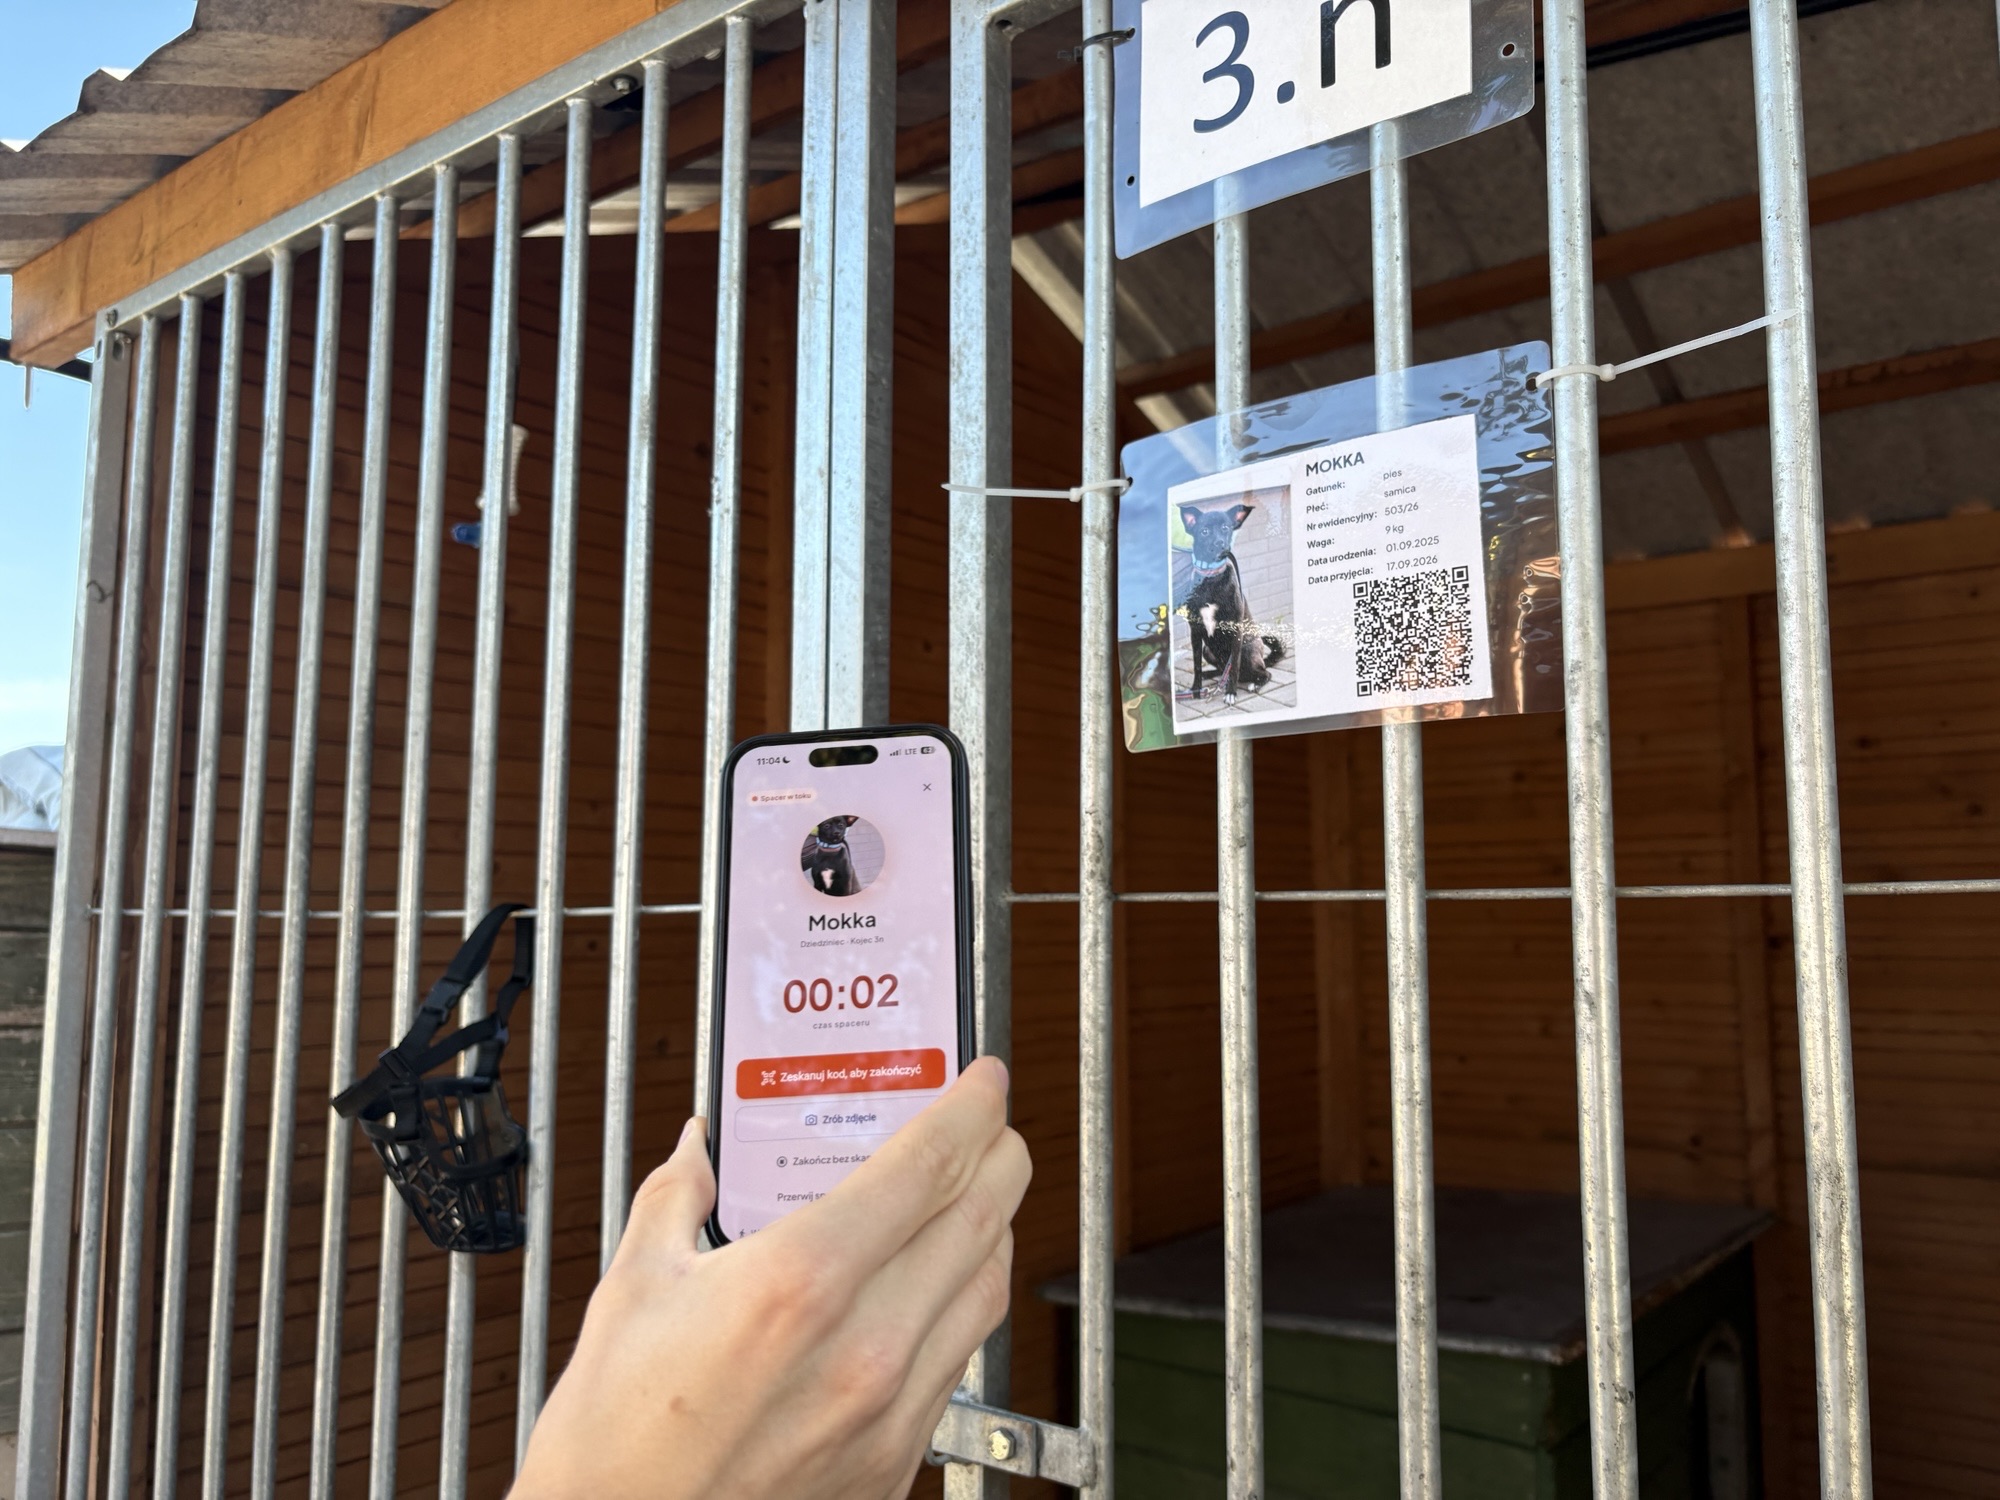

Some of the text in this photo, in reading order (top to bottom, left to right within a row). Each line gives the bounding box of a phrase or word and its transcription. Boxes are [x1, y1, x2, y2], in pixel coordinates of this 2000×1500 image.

[1306, 451, 1365, 477] MOKKA
[1305, 469, 1403, 496] Gatunek: pies
[1306, 485, 1416, 514] Płeć: samica
[1306, 502, 1419, 532] Nr ewidencyjny: 503/26
[1306, 524, 1404, 549] Waga: 9 kg
[1307, 535, 1440, 567] Data urodzenia: 01.09.2025
[1308, 555, 1438, 585] Data przyjęcia: 17.09.2026
[757, 756, 780, 765] 11:04
[808, 912, 877, 931] Mokka
[800, 936, 884, 948] Dziedziniec Kojec 3n
[783, 974, 899, 1013] 00:02
[812, 1019, 870, 1030] czas spaceru
[780, 1064, 922, 1083] Zeskanuj kod, aby zakończyć
[822, 1111, 877, 1126] Zrób zdjęcie
[793, 1155, 831, 1166] Zakończ
[832, 1155, 849, 1164] bez
[777, 1191, 814, 1202] Przerwij
